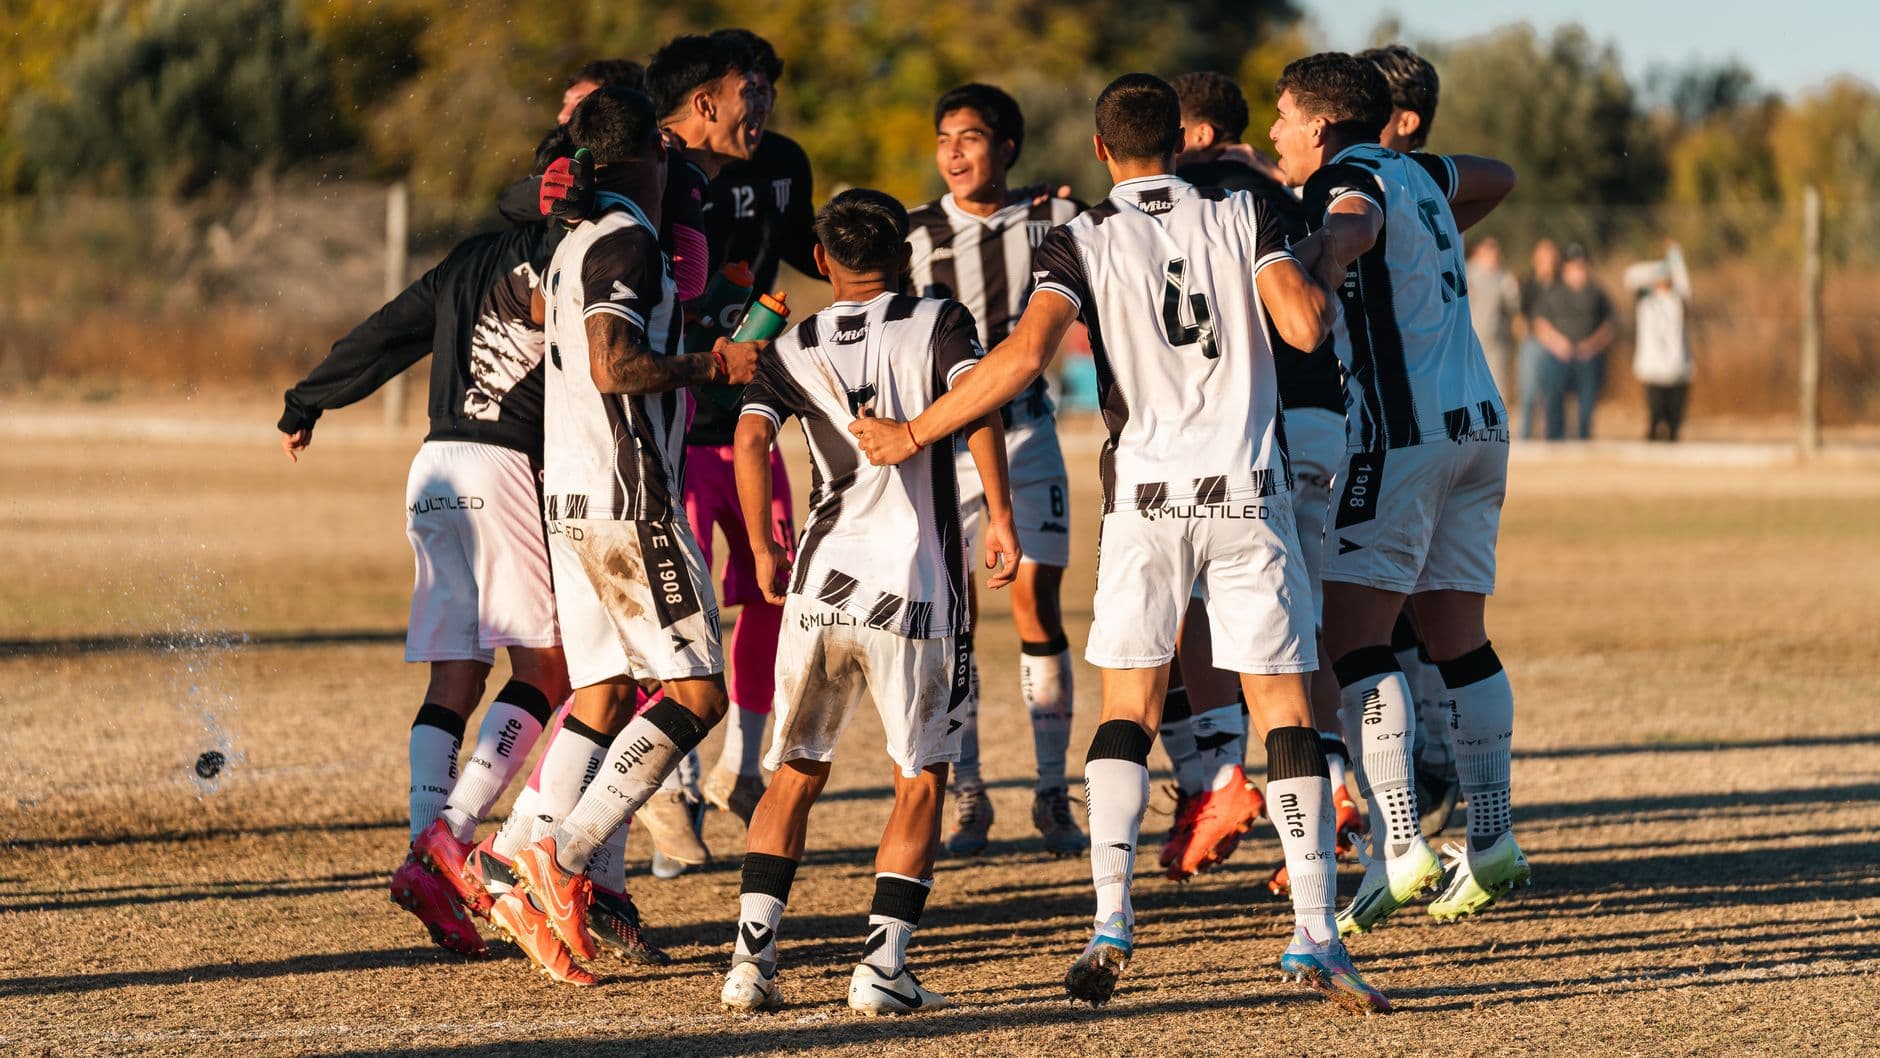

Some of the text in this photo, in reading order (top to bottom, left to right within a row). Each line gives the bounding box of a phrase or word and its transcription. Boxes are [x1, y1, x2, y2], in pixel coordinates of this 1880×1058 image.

[731, 185, 755, 218] 12
[1163, 257, 1219, 359] 4
[1465, 428, 1510, 443] MULTIL
[1049, 485, 1063, 517] 8
[1349, 463, 1374, 507] 1908
[408, 496, 484, 516] MULTILED
[1159, 505, 1270, 519] MULTILED
[657, 558, 683, 605] 1908
[956, 642, 968, 688] 1908
[1361, 688, 1386, 725] mitre
[496, 718, 522, 758] mitre
[1377, 730, 1412, 741] GYE
[614, 736, 655, 775] mitre
[1279, 793, 1305, 838] mitre
